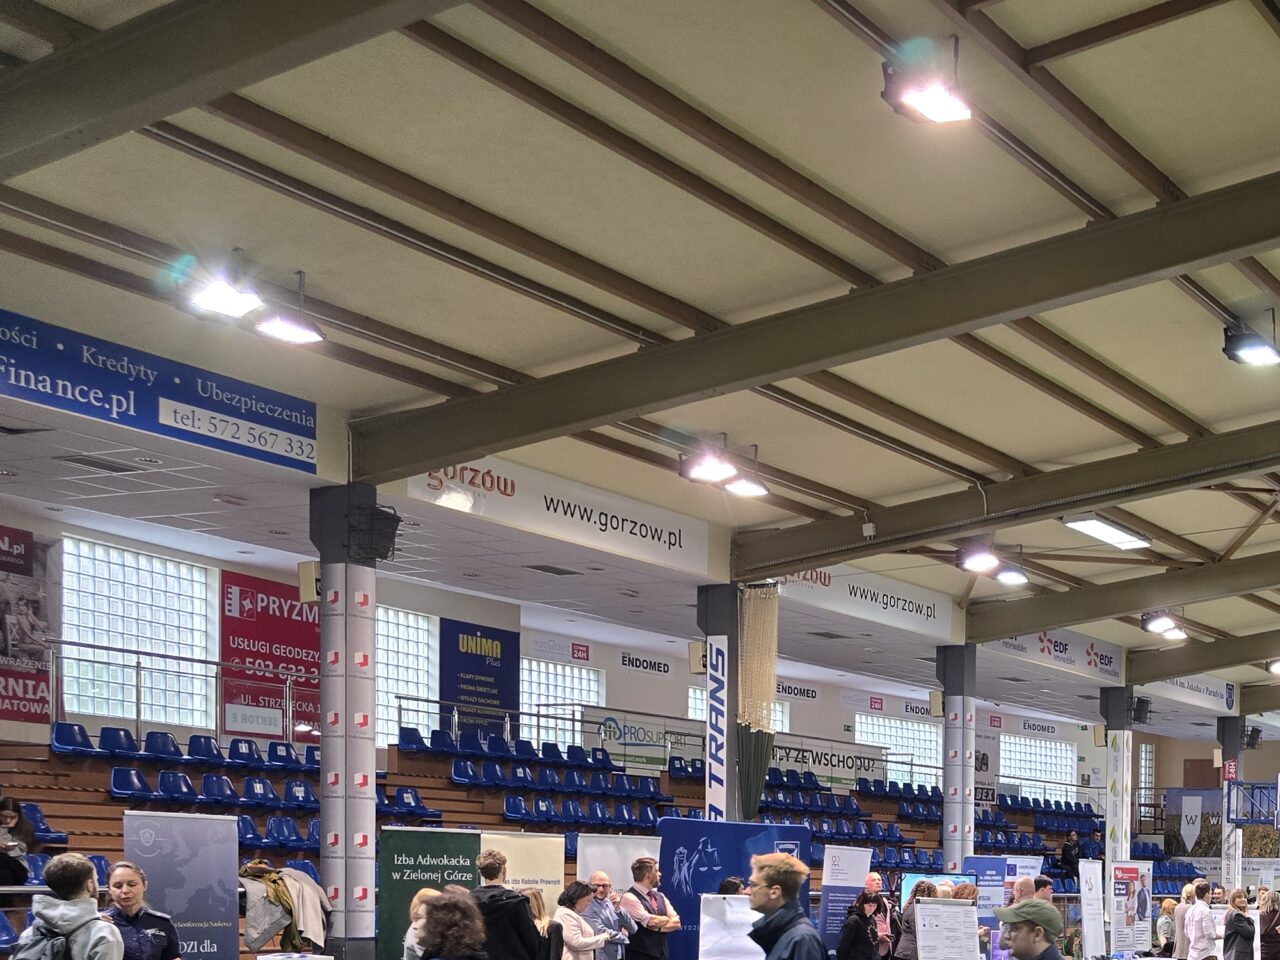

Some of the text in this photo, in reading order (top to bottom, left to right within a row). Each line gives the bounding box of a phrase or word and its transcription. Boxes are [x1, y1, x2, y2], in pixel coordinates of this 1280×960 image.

[82, 345, 158, 385] Kredyty
[196, 378, 315, 428] Ubezpieczenia
[173, 407, 316, 460] tel: 572 567 332
[544, 495, 683, 550] www.gorzow.pl
[848, 583, 936, 621] www.gorzow.pl
[229, 636, 321, 663] USŁUGI GEODEZY
[573, 650, 587, 658] 24H
[245, 657, 274, 678] 502
[486, 657, 502, 667] Plus
[621, 655, 670, 673] ENDOMED
[0, 698, 51, 715] ATOWA
[241, 694, 315, 713] UL. STRZEECKA
[708, 643, 726, 789] TRANS
[1023, 722, 1056, 734] ENDOMED
[394, 854, 470, 866] Izba Adwokacka
[392, 869, 473, 883] w Zielonej Górze
[200, 940, 218, 953] dla
